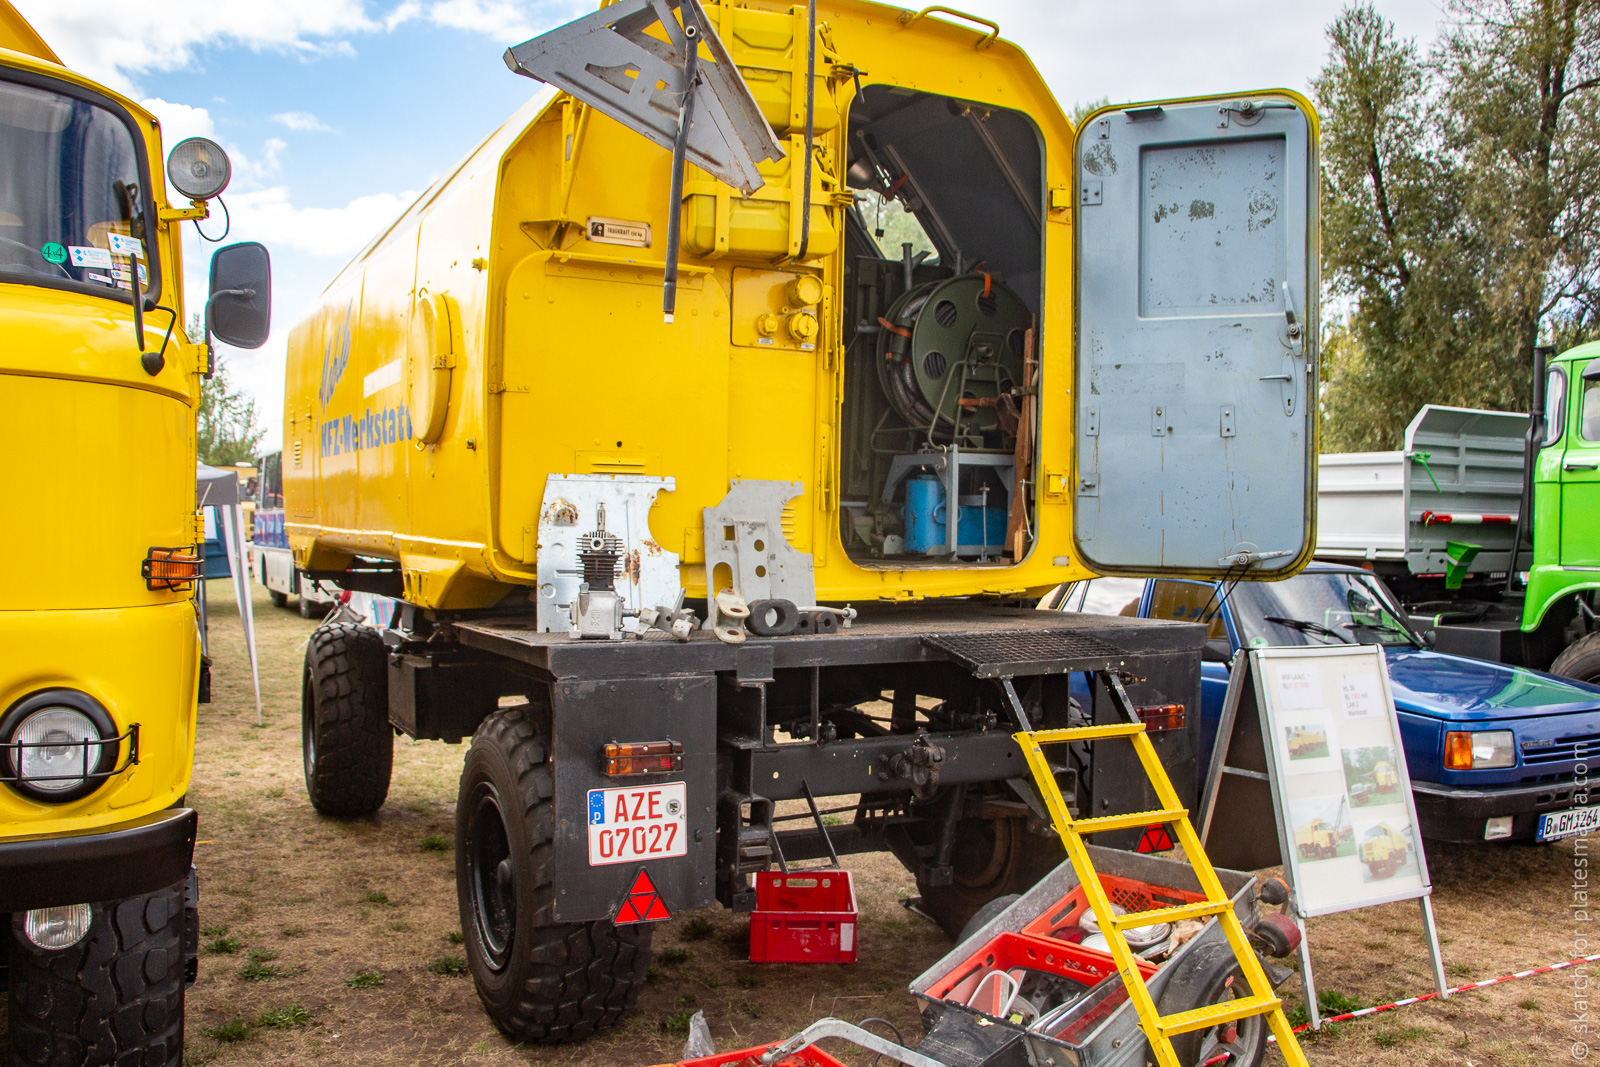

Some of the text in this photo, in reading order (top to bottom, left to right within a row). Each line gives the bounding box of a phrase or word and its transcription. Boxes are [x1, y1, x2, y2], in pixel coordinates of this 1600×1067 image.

[607, 227, 630, 236] TRAGKRAFT
[43, 245, 64, 260] 4x4
[320, 398, 413, 458] KFZ-Werkstatt
[593, 791, 663, 823] D AZE
[1545, 817, 1553, 835] B
[599, 822, 678, 858] 07027
